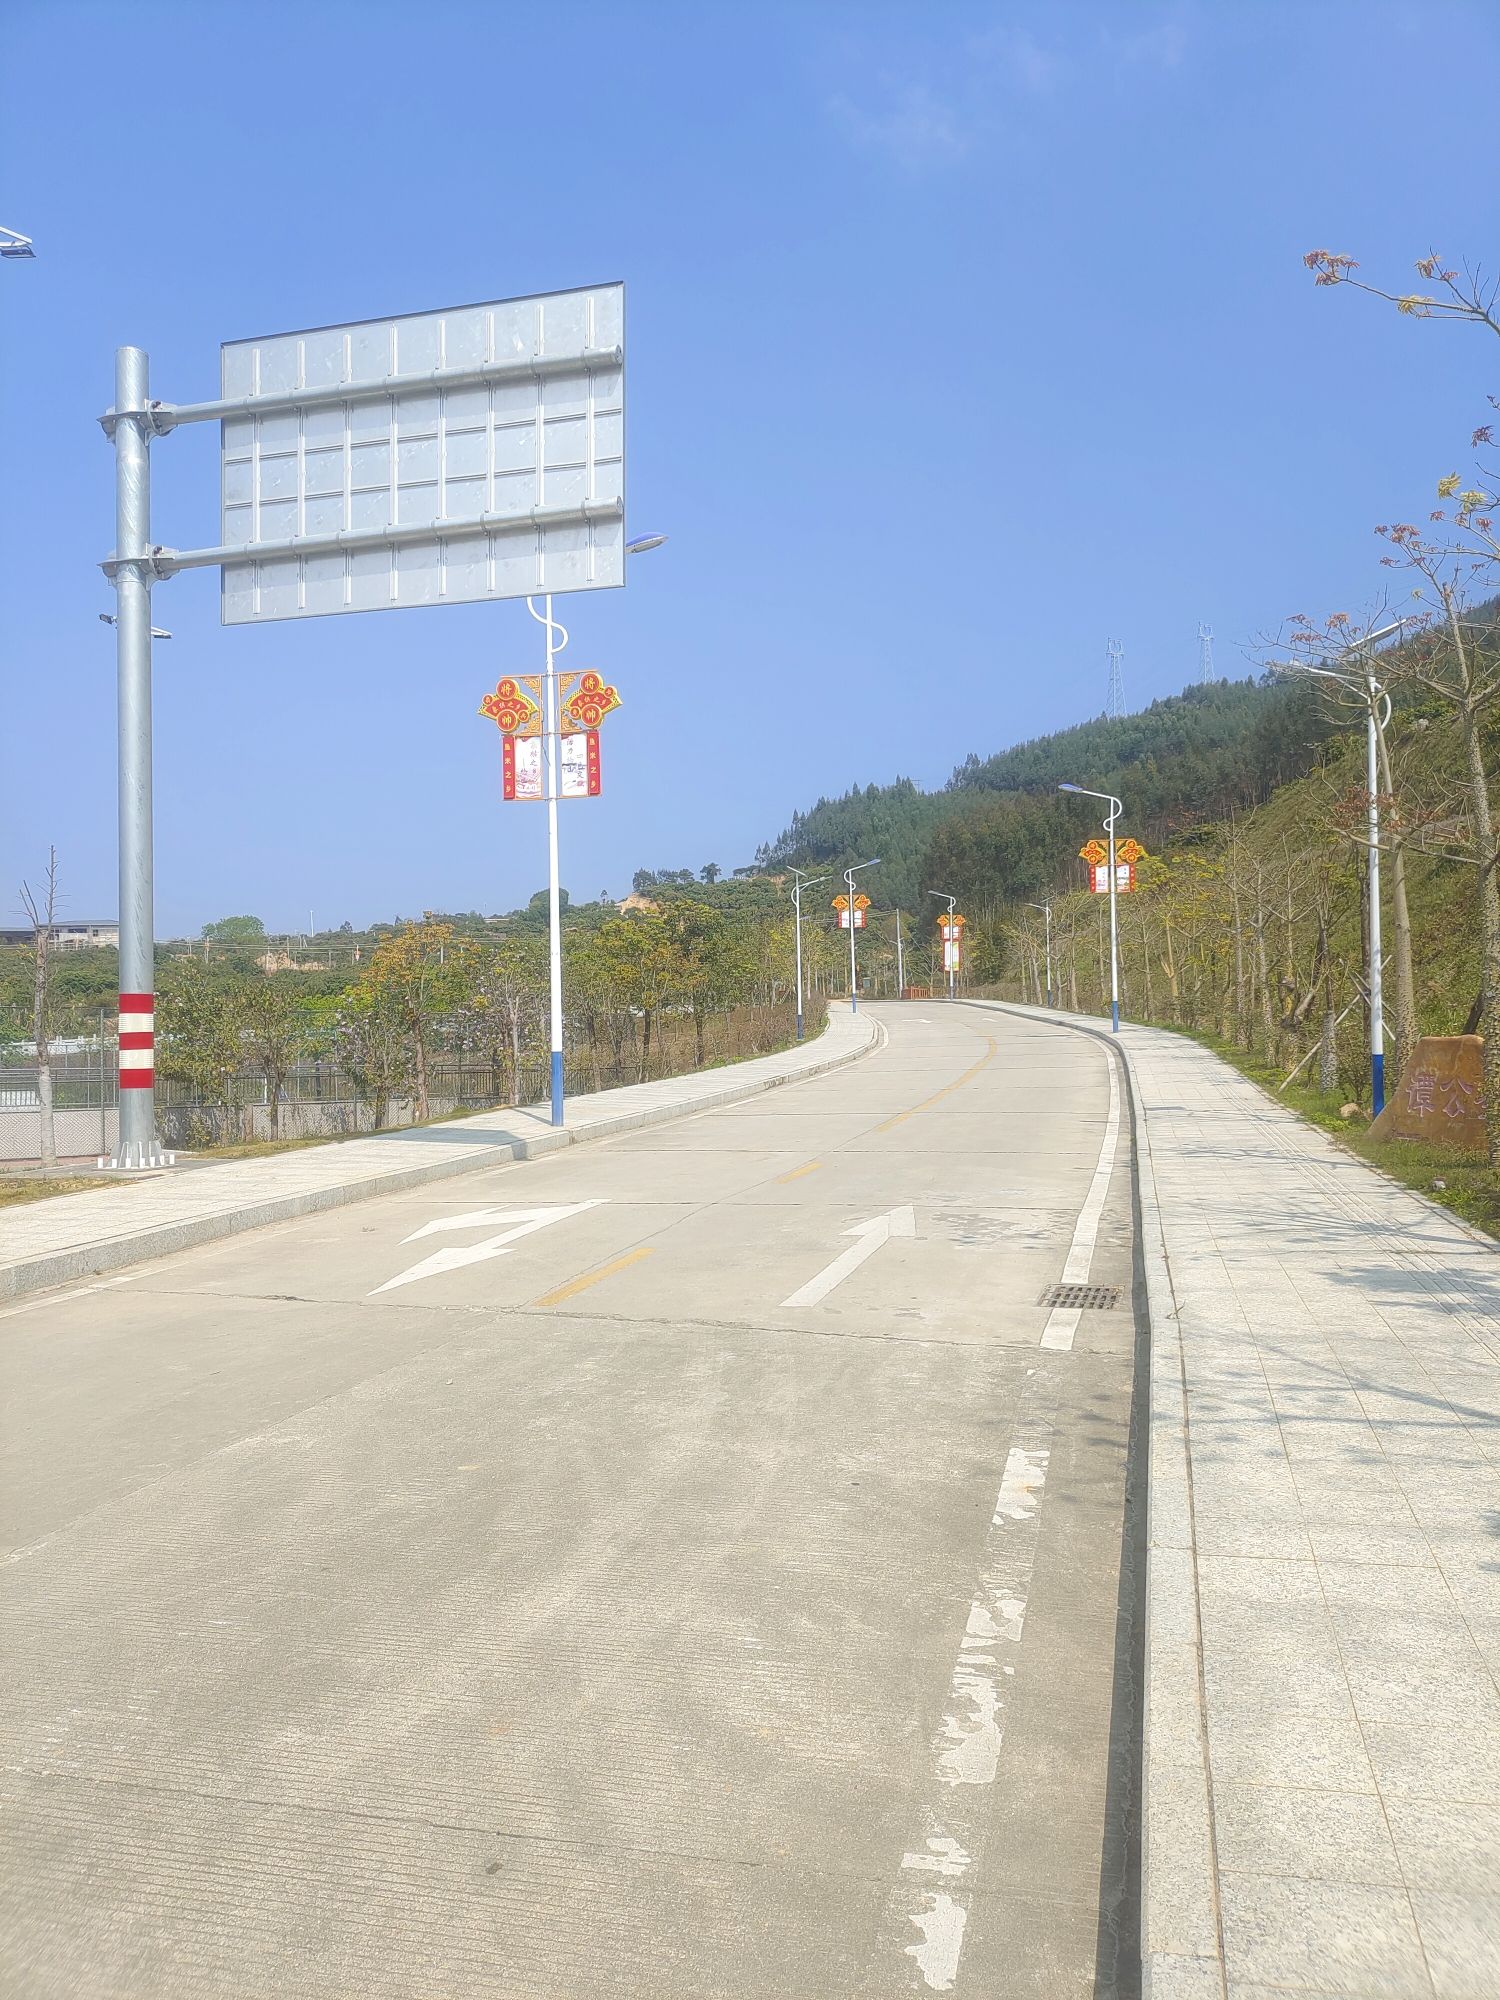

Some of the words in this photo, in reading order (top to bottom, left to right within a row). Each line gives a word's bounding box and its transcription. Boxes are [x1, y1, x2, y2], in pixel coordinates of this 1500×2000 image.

[504, 742, 512, 793] 鱼米之乡
[589, 737, 597, 788] 鱼米之乡
